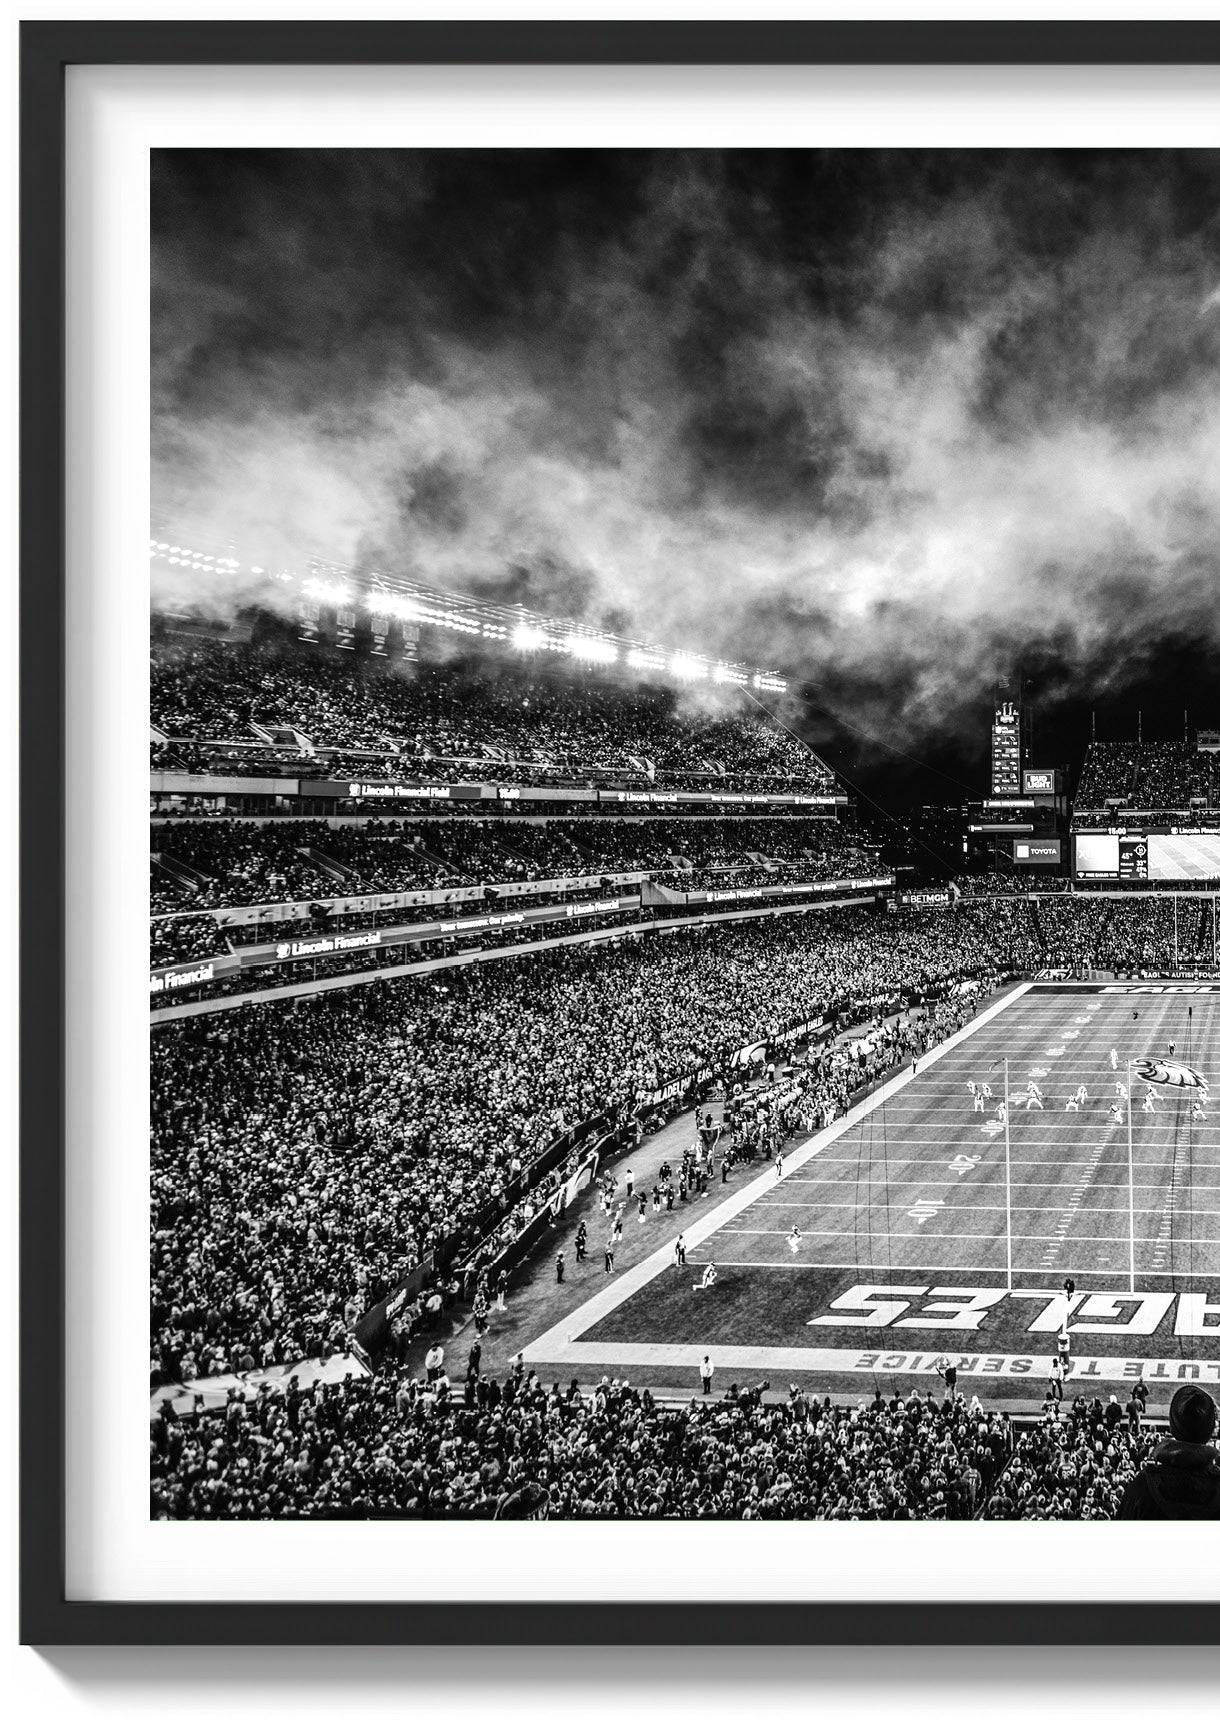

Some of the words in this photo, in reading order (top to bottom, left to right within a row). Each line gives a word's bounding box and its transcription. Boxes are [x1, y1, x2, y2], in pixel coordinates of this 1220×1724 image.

[362, 785, 394, 797] Lincoln
[394, 786, 430, 798] Financial
[431, 786, 450, 798] Field
[1028, 781, 1051, 789] LIGHT
[626, 792, 650, 802] Lincoln
[650, 792, 678, 802] Financial
[714, 890, 736, 901] Lincoln
[736, 889, 762, 900] Financial
[910, 893, 949, 903] BETMGM
[291, 939, 334, 956] Lincoln
[334, 931, 382, 950] Financial
[164, 963, 214, 989] Financial
[948, 1154, 982, 1171] 20
[907, 1198, 946, 1218] 10
